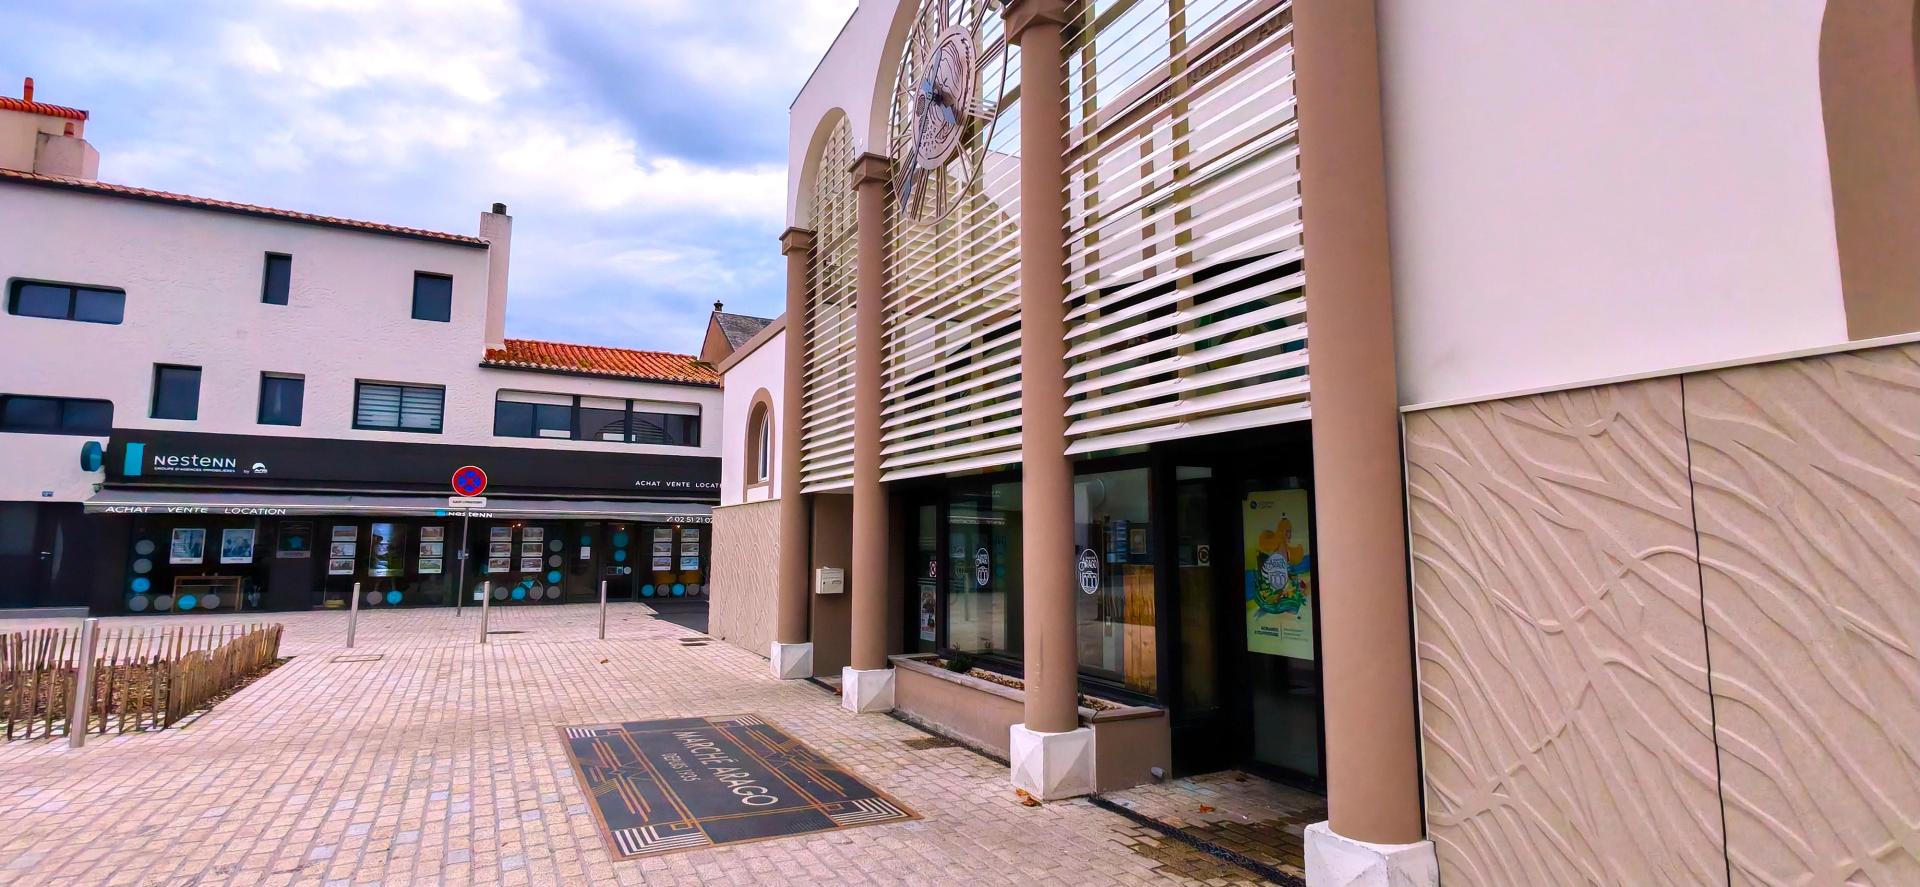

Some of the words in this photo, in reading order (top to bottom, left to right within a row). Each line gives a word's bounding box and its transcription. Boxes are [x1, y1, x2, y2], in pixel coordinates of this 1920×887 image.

[105, 506, 151, 514] ACHAT
[224, 507, 287, 516] LOCATION
[708, 767, 779, 806] ARAGO
